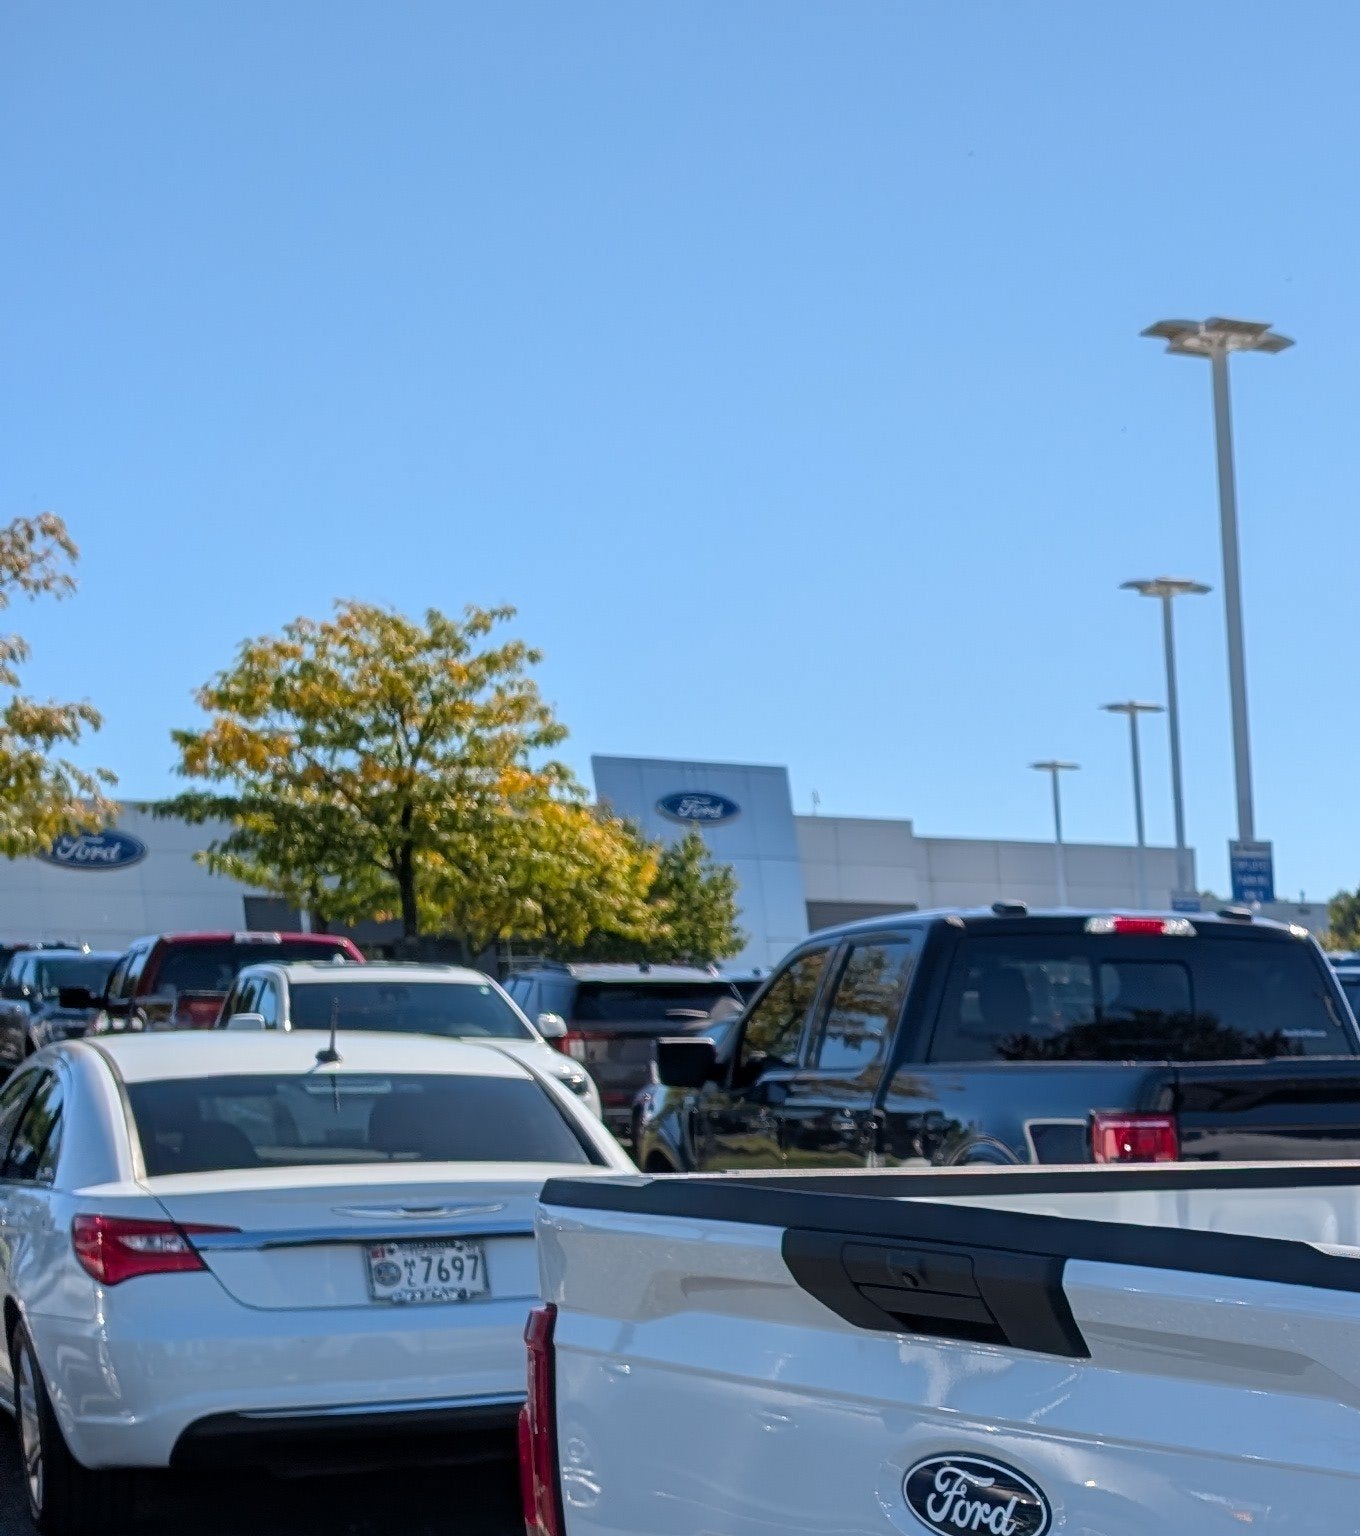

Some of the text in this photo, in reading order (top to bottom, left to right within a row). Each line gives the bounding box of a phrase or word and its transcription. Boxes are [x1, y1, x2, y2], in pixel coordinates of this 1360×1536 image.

[677, 796, 723, 818] Ford
[56, 835, 121, 860] Ford
[420, 1254, 479, 1284] 7697
[926, 1466, 1019, 1536] Ford
